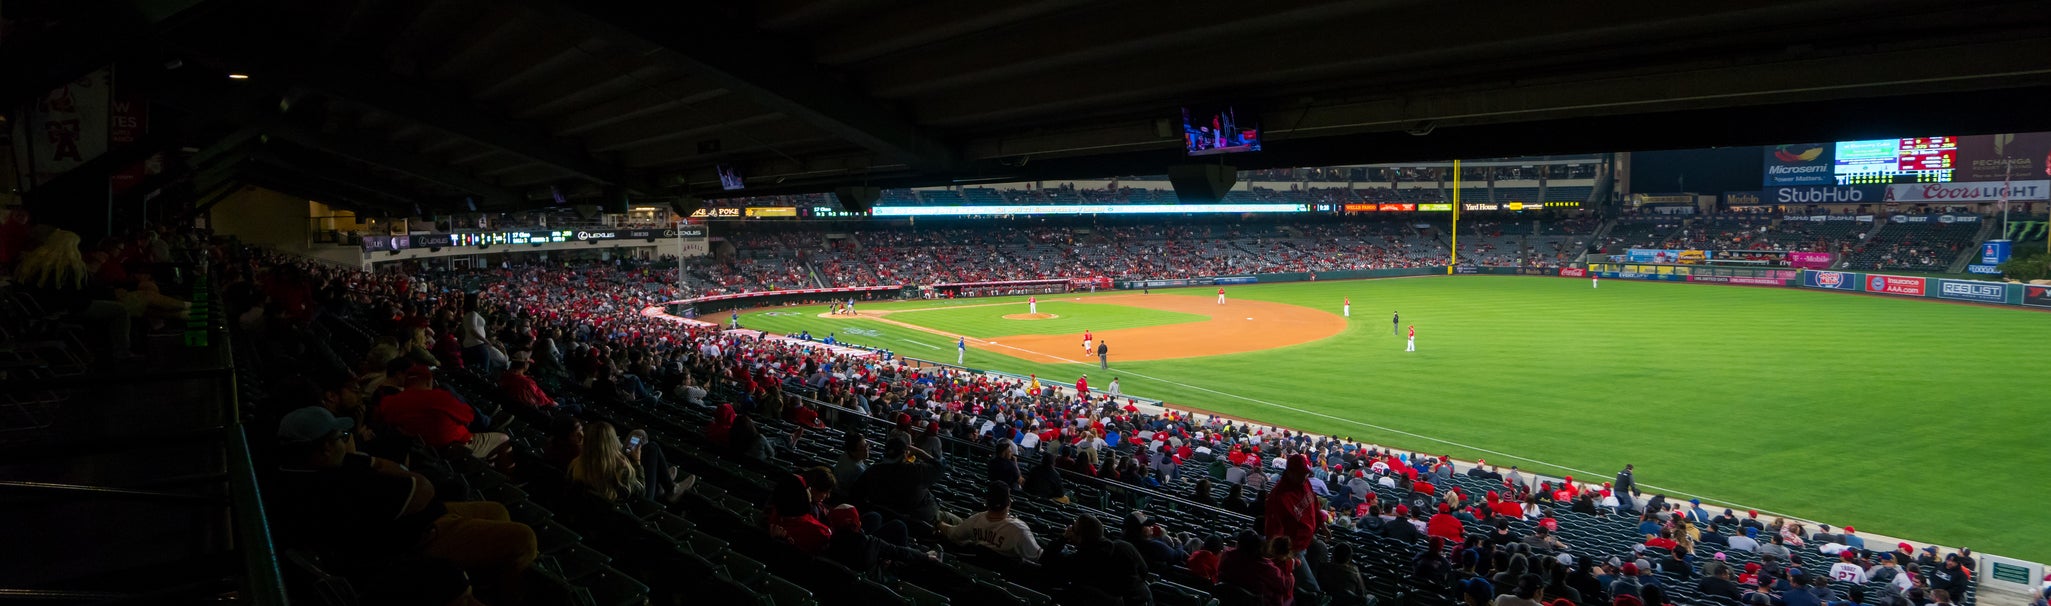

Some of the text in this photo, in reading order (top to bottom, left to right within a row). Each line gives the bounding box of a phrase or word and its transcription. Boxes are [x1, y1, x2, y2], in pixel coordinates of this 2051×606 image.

[1768, 163, 1828, 175] Microsemi
[1778, 187, 1863, 203] StubHub
[1922, 183, 2038, 200] Coors LIGHT
[1727, 194, 1760, 204] Modelo
[1887, 277, 1920, 286] Insurance
[1886, 286, 1919, 294] AAA.com
[973, 528, 1005, 548] PUJOLS
[1838, 571, 1857, 582] 27
